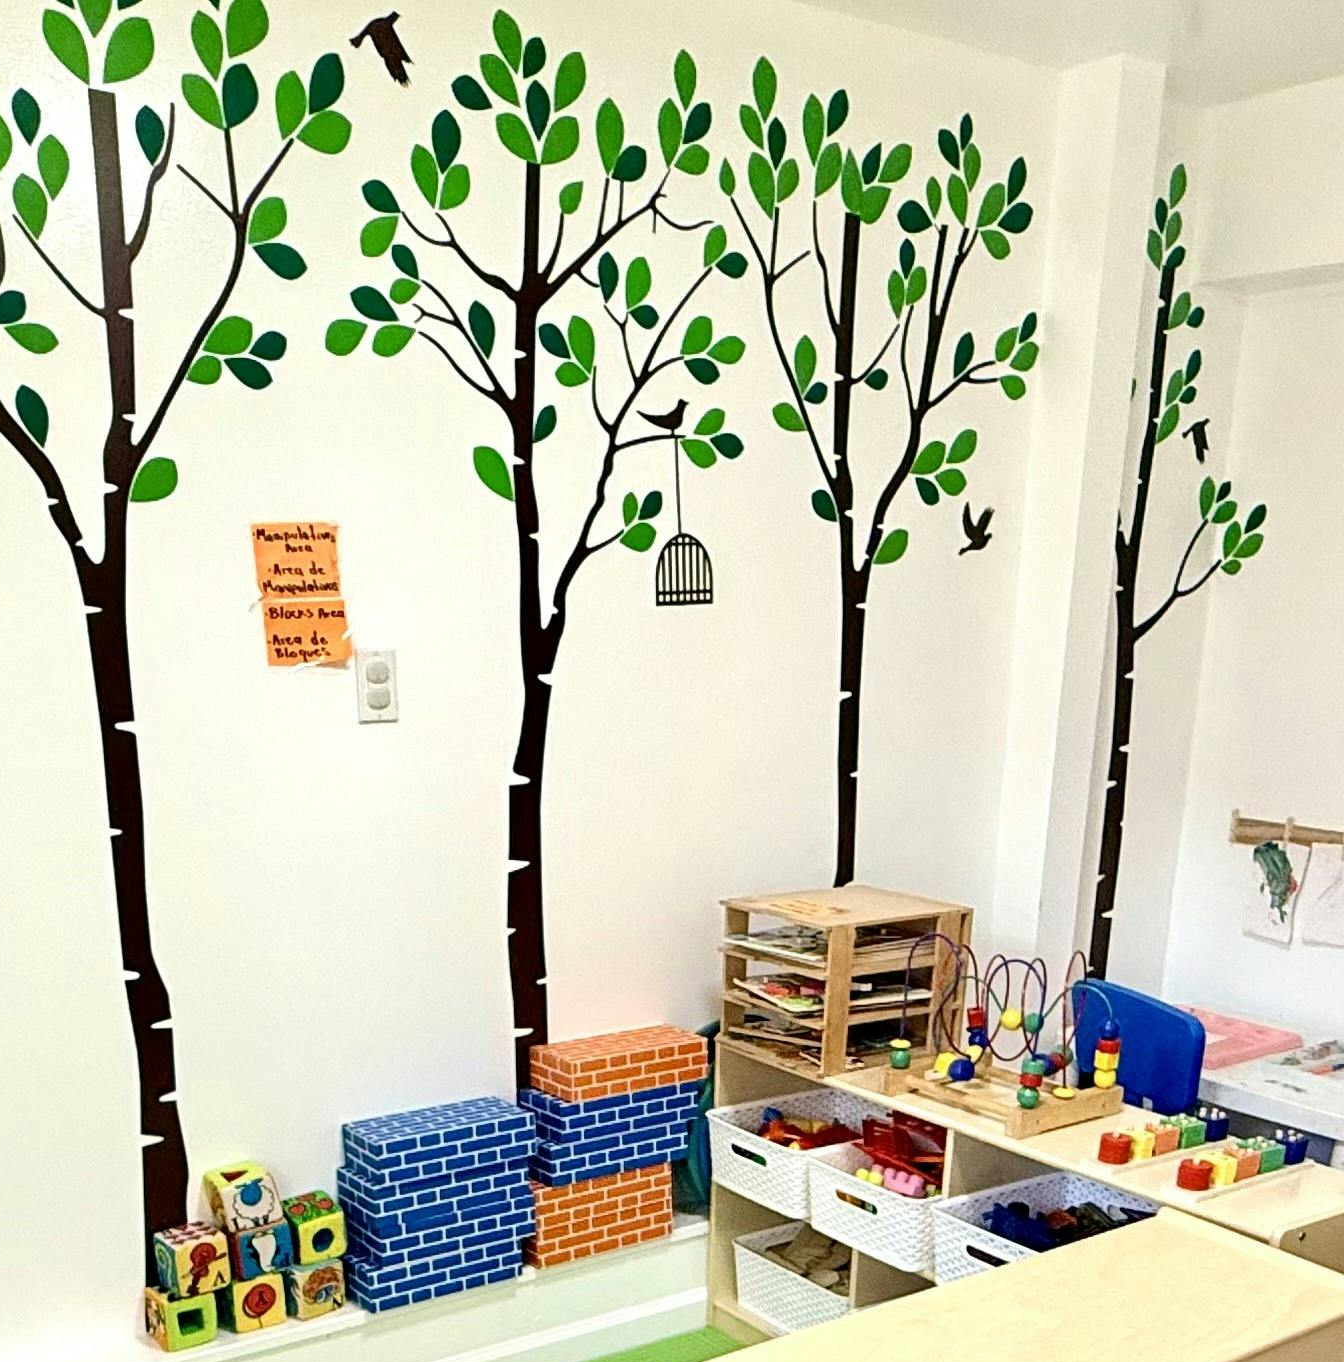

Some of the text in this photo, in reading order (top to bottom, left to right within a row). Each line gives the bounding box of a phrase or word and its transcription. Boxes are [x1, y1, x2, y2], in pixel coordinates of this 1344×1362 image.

[285, 543, 313, 553] Area
[273, 561, 326, 576] Area de
[268, 606, 345, 620] Blocks Area
[272, 630, 329, 646] Area de
